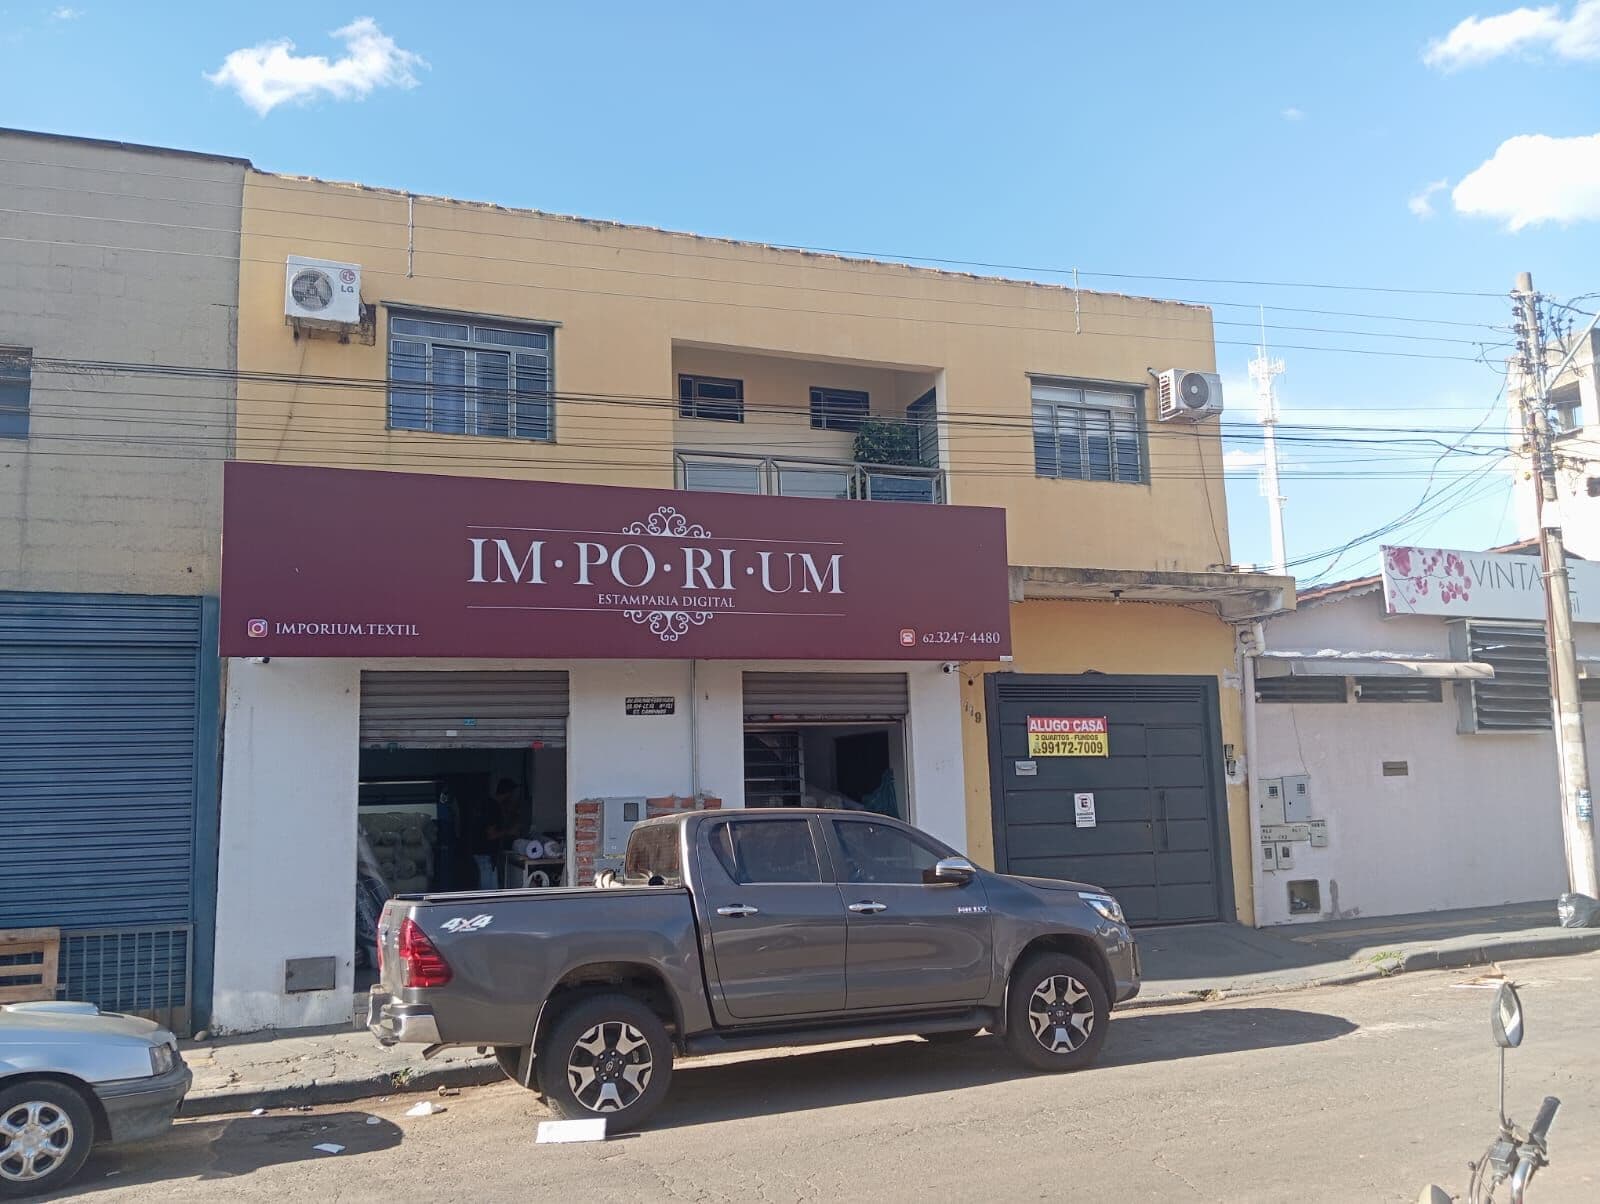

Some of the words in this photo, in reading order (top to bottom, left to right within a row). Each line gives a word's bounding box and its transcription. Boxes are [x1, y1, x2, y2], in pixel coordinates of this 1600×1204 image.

[341, 285, 354, 293] LG
[1470, 559, 1577, 594] VINTAE
[598, 593, 677, 607] ESTAMPARIA
[682, 596, 736, 608] DIGITAL
[275, 622, 420, 636] IMPORIUM.TEXTIL
[1029, 720, 1070, 731] ALUGO
[1073, 720, 1104, 731] CASA
[1041, 741, 1103, 754] 99172-7009
